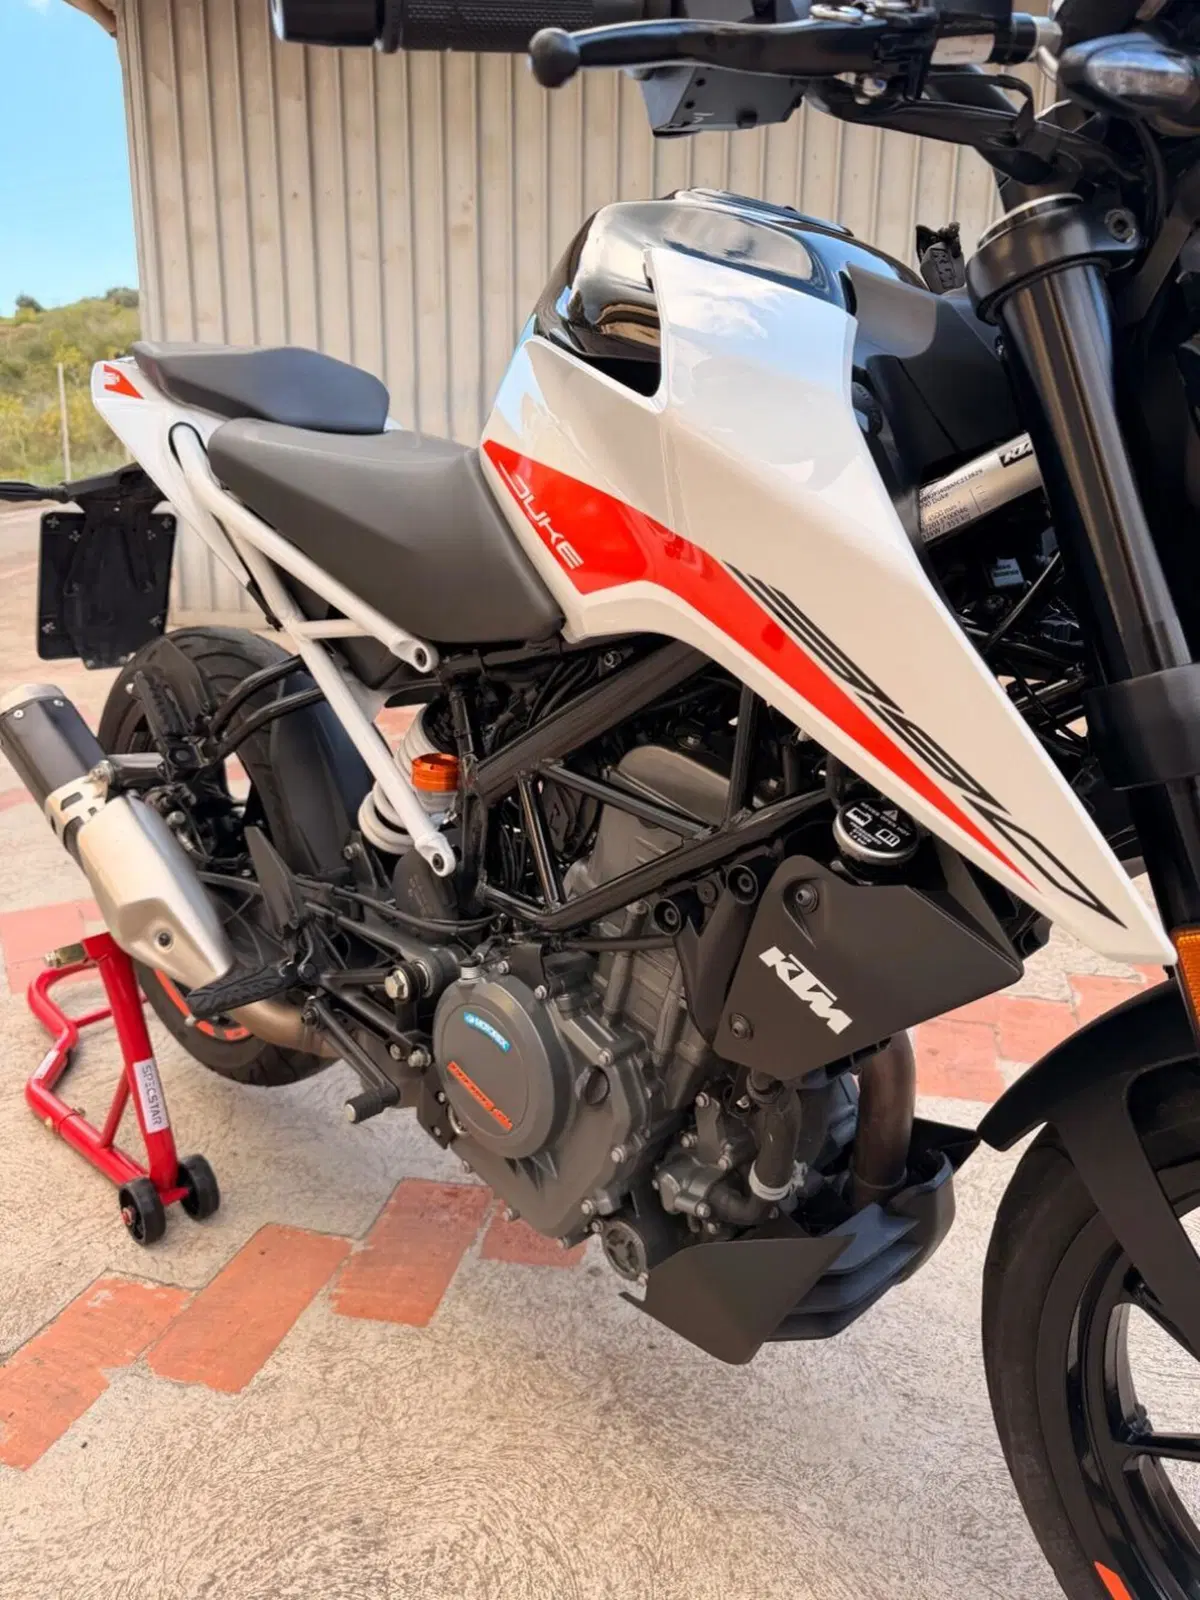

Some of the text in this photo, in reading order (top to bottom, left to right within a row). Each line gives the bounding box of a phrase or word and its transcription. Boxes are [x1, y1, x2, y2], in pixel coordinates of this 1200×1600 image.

[498, 461, 585, 570] DUKE
[758, 945, 853, 1036] KTM
[141, 1065, 162, 1125] SPECSTAR
